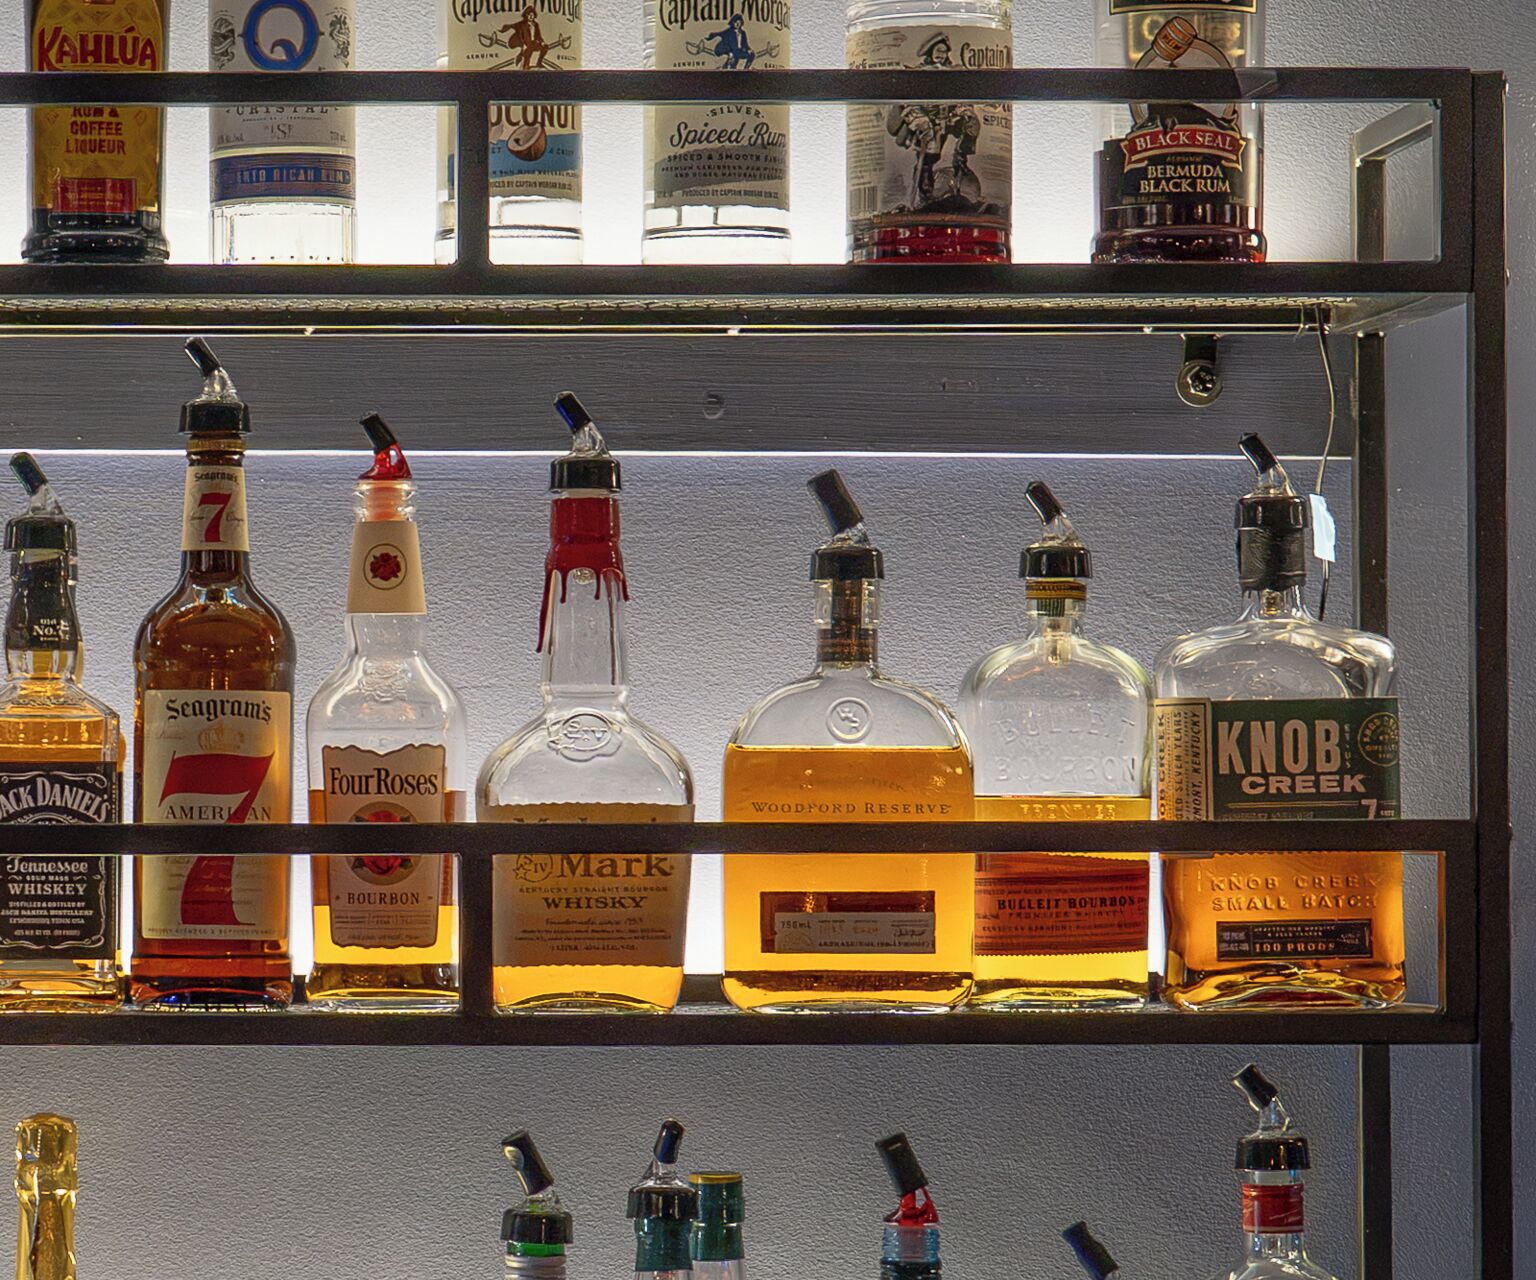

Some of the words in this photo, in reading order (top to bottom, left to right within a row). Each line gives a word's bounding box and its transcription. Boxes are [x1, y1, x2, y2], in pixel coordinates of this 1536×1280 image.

[38, 26, 158, 71] KAHLÚA
[710, 106, 761, 118] SILVER
[70, 120, 124, 137] COFFEE
[669, 121, 745, 149] Spiced
[748, 121, 787, 147] Rum
[65, 138, 127, 156] LIQUEUR
[1135, 131, 1192, 151] BLACK
[1194, 131, 1235, 151] SEAL
[666, 154, 704, 163] SPICED
[717, 154, 761, 163] SMOOTH
[1147, 164, 1224, 179] BERMUDA
[1139, 179, 1196, 194] BLACK
[1196, 179, 1231, 194] RUM
[197, 491, 233, 543] 7
[166, 696, 273, 726] Seagram's
[1218, 718, 1342, 775] KNOB
[329, 766, 375, 795] Four
[375, 766, 438, 795] Roses
[1240, 774, 1367, 795] CREEK
[36, 776, 112, 823] DANIEL'S
[752, 801, 857, 815] WOODFORD
[864, 801, 953, 815] RESERVE
[165, 805, 272, 821] AMERIAN
[6, 855, 89, 873] Tennessee
[555, 853, 672, 879] Mark
[7, 883, 87, 896] WHISKEY
[1210, 873, 1280, 892] KNOB
[347, 891, 420, 905] BOURBON
[542, 896, 647, 910] WHISKY
[997, 897, 1061, 911] BULLEIT
[1066, 894, 1136, 909] BOURBON
[1212, 895, 1290, 912] SMALL
[1254, 943, 1282, 953] 100
